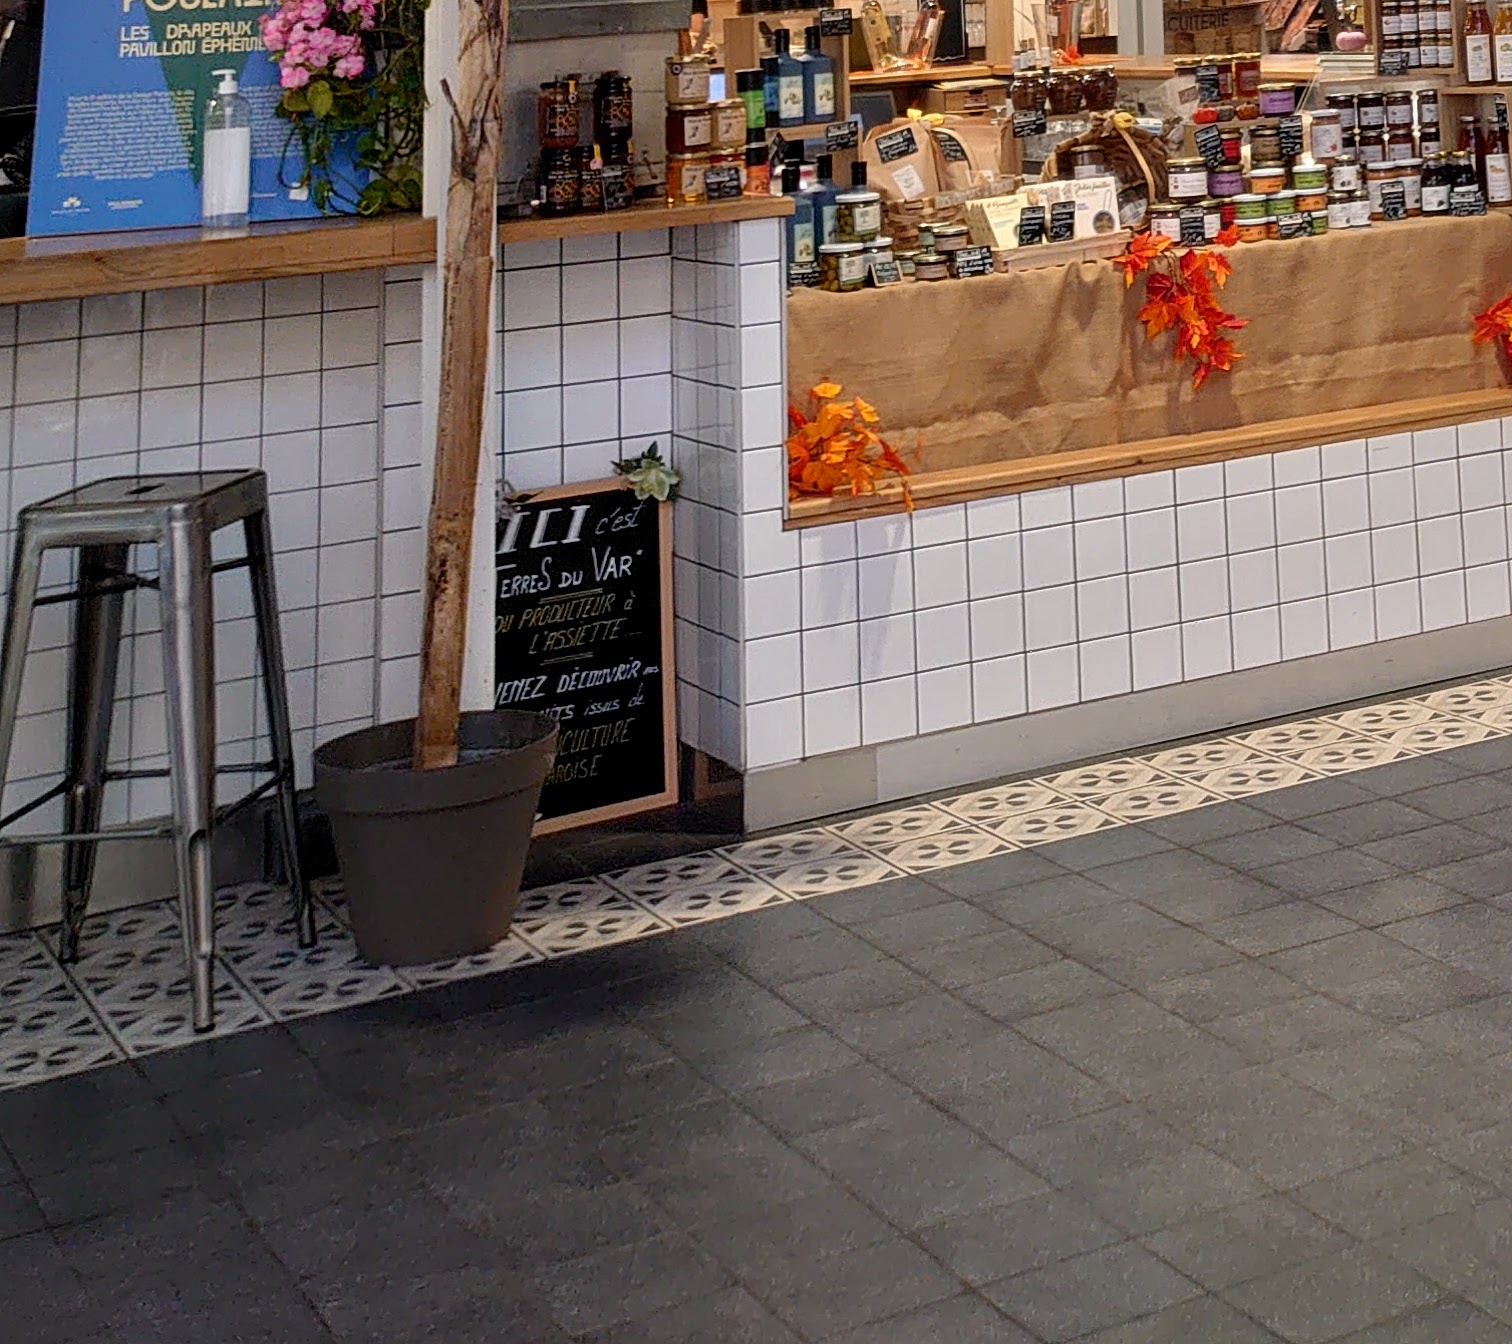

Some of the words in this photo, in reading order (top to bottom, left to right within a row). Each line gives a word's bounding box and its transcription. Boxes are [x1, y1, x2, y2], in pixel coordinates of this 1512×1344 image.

[119, 25, 151, 43] LES
[165, 20, 253, 40] DRAPEAUX
[1164, 12, 1230, 32] CUITERIE
[119, 39, 196, 59] PAVILLON
[496, 504, 592, 555] ICI
[595, 499, 647, 535] c'est
[517, 593, 616, 630] PRODUCTEUR
